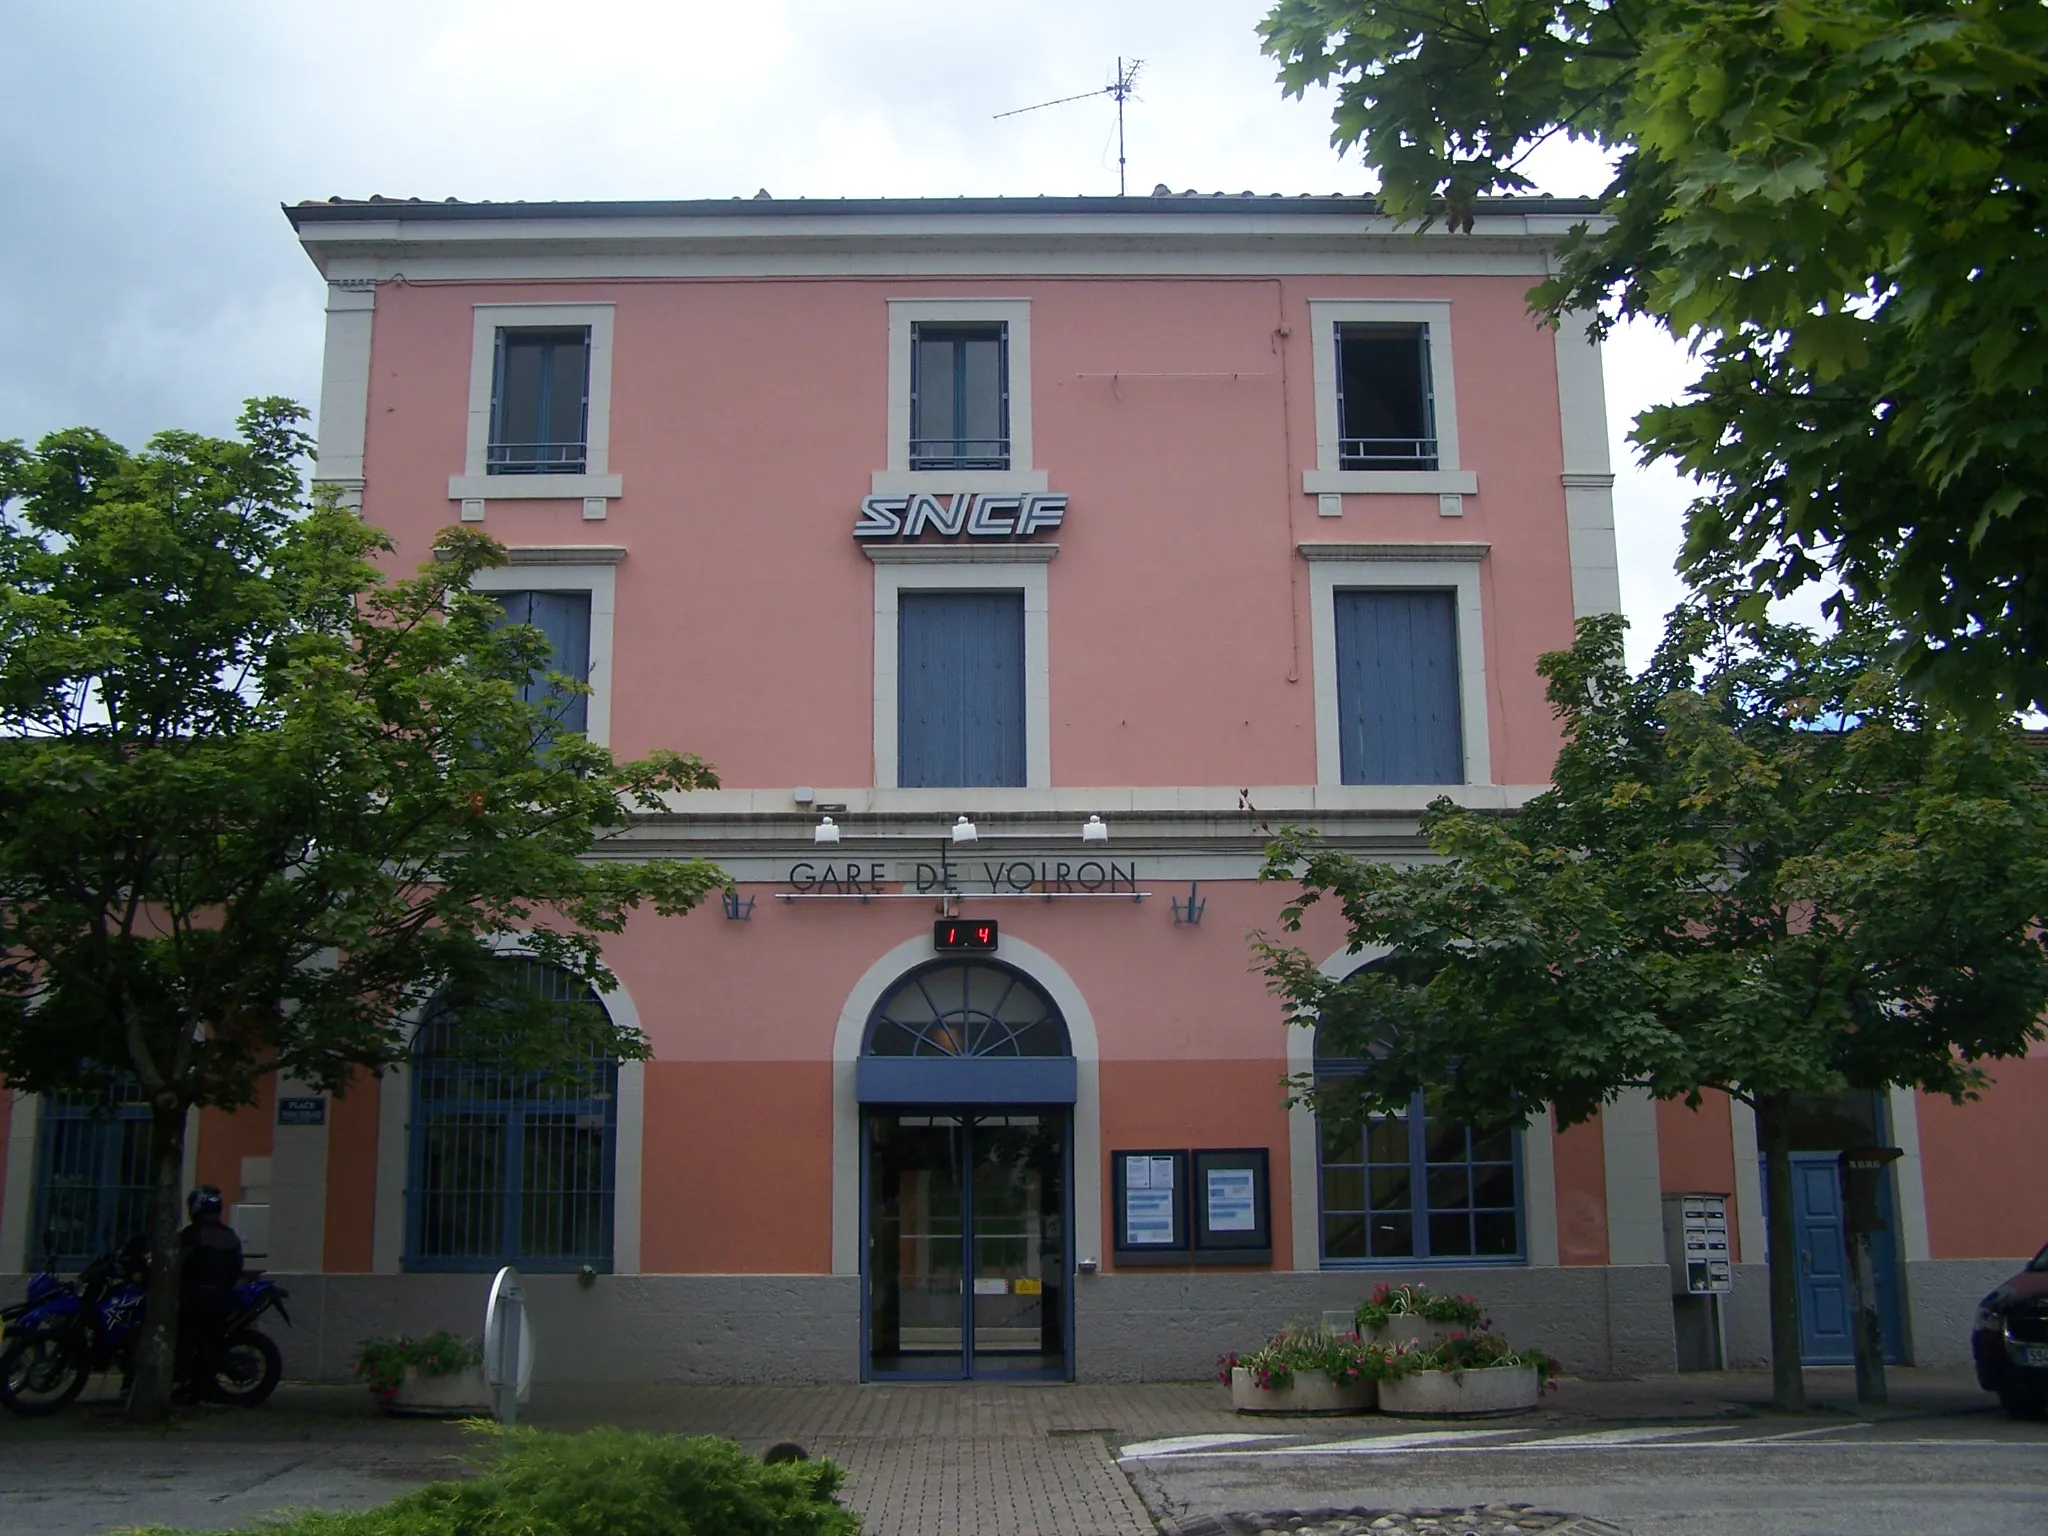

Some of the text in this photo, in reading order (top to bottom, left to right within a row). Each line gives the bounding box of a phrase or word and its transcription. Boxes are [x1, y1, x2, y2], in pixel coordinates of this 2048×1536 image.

[853, 493, 1069, 537] SNCF
[790, 861, 1136, 892] GARE DE VOIRON
